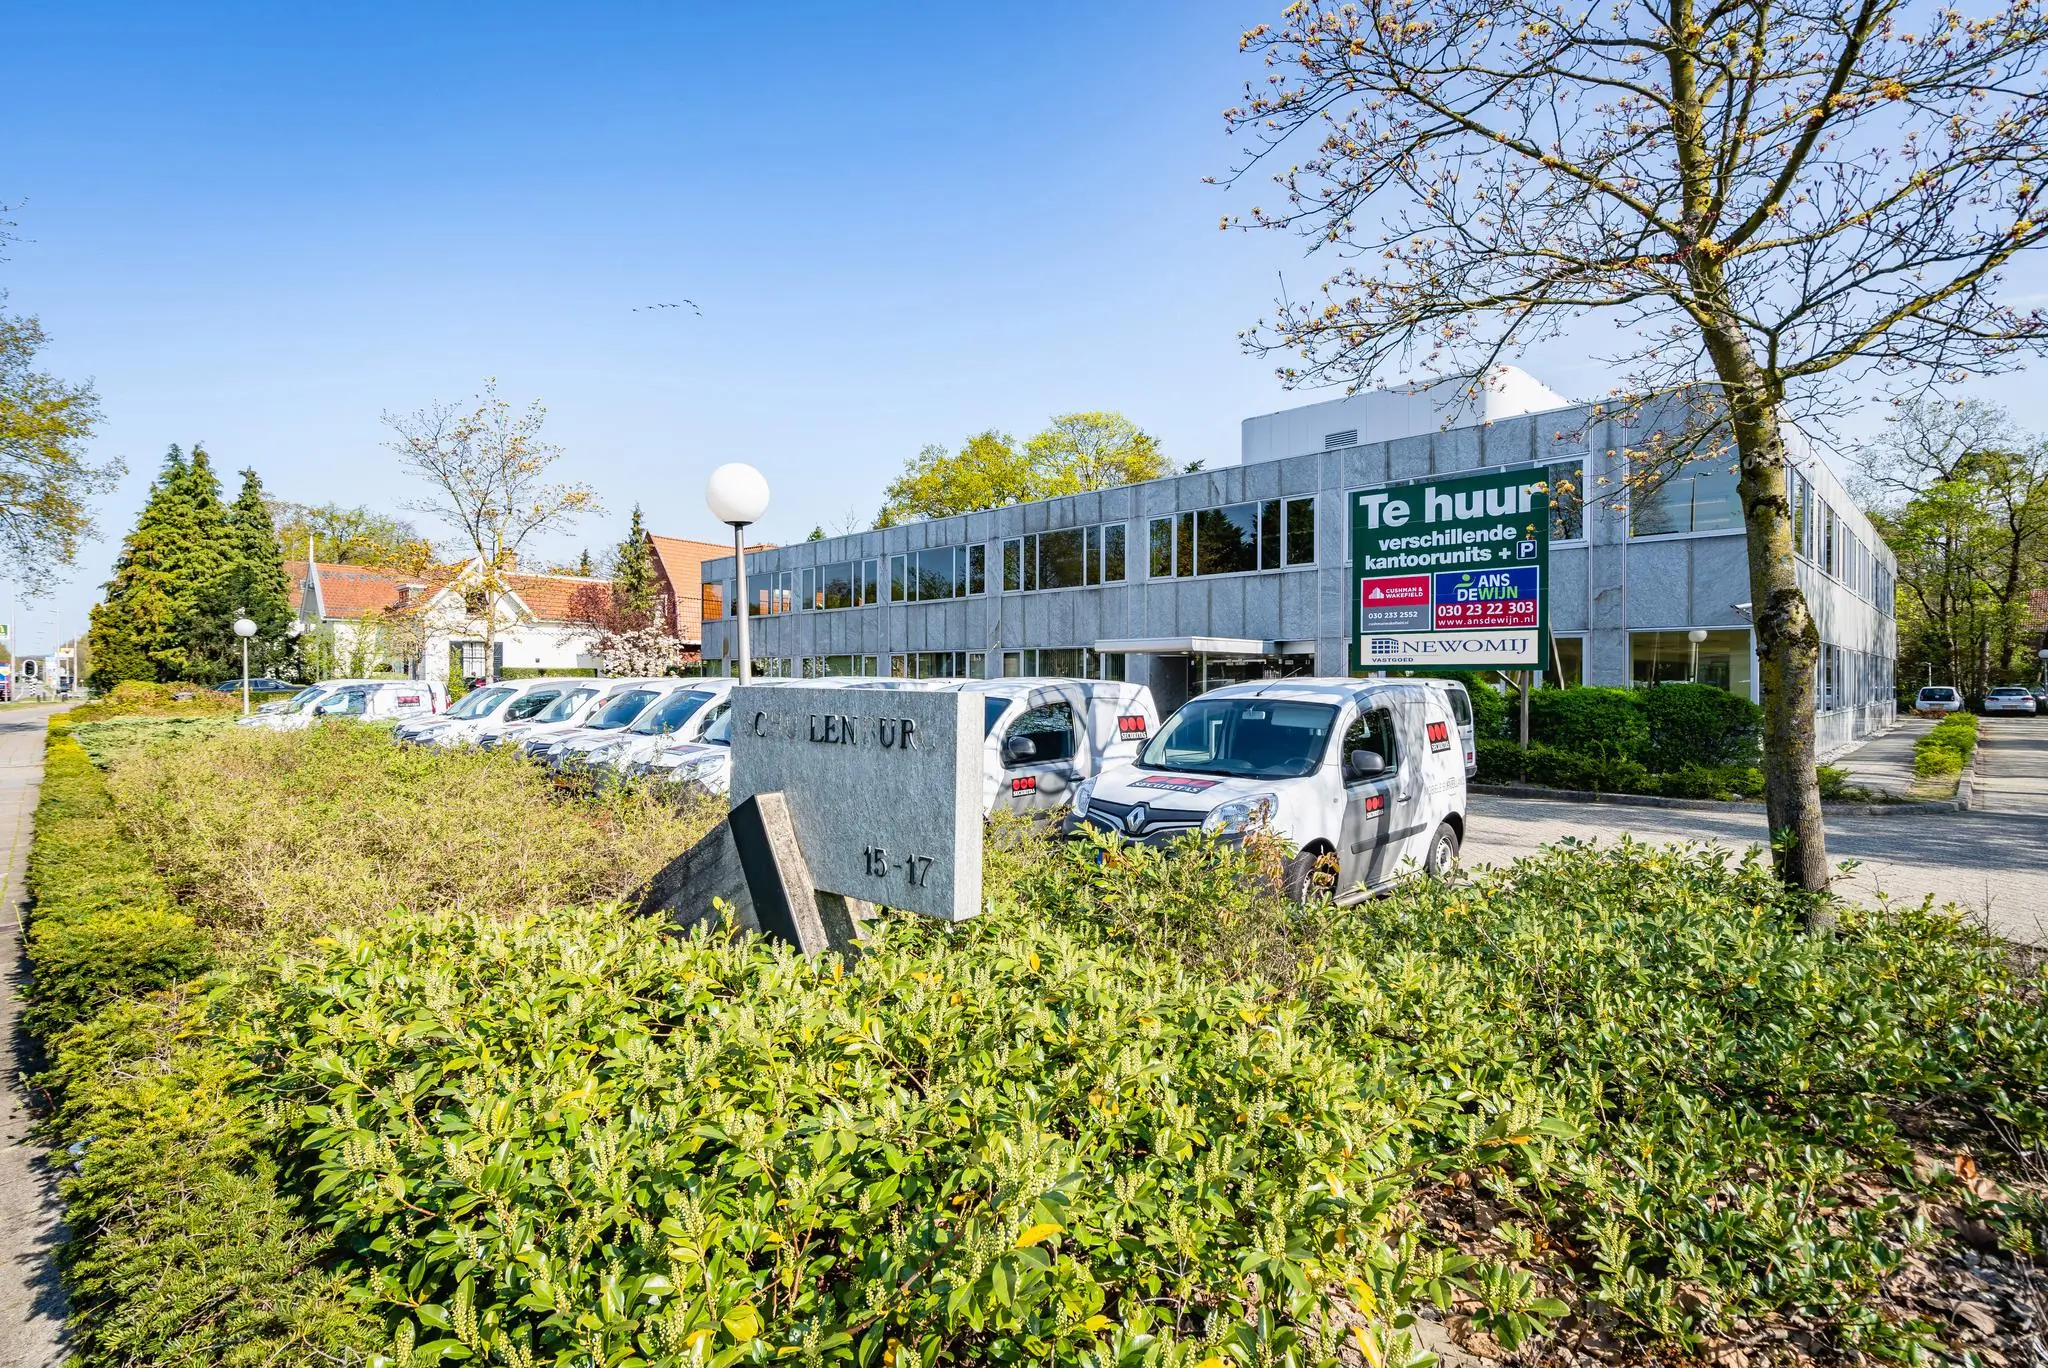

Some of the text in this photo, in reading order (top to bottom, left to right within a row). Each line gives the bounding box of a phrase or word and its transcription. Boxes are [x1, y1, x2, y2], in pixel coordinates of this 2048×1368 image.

[1359, 484, 1547, 529] Te huur
[1379, 524, 1517, 550] verschillende
[1365, 547, 1492, 570] kantoorunits
[1520, 542, 1534, 557] P
[1478, 573, 1511, 588] ANS
[1385, 591, 1424, 599] WAKEFIELD
[1384, 611, 1398, 619] 233
[1438, 601, 1534, 617] 030 23 22 303
[1438, 614, 1534, 626] www.ansdewijn.nl
[1402, 638, 1529, 655] NEWOMIJ
[1121, 731, 1148, 740] SECURITAS
[1132, 781, 1201, 793] SECURITAS
[863, 845, 935, 888] 15-17
